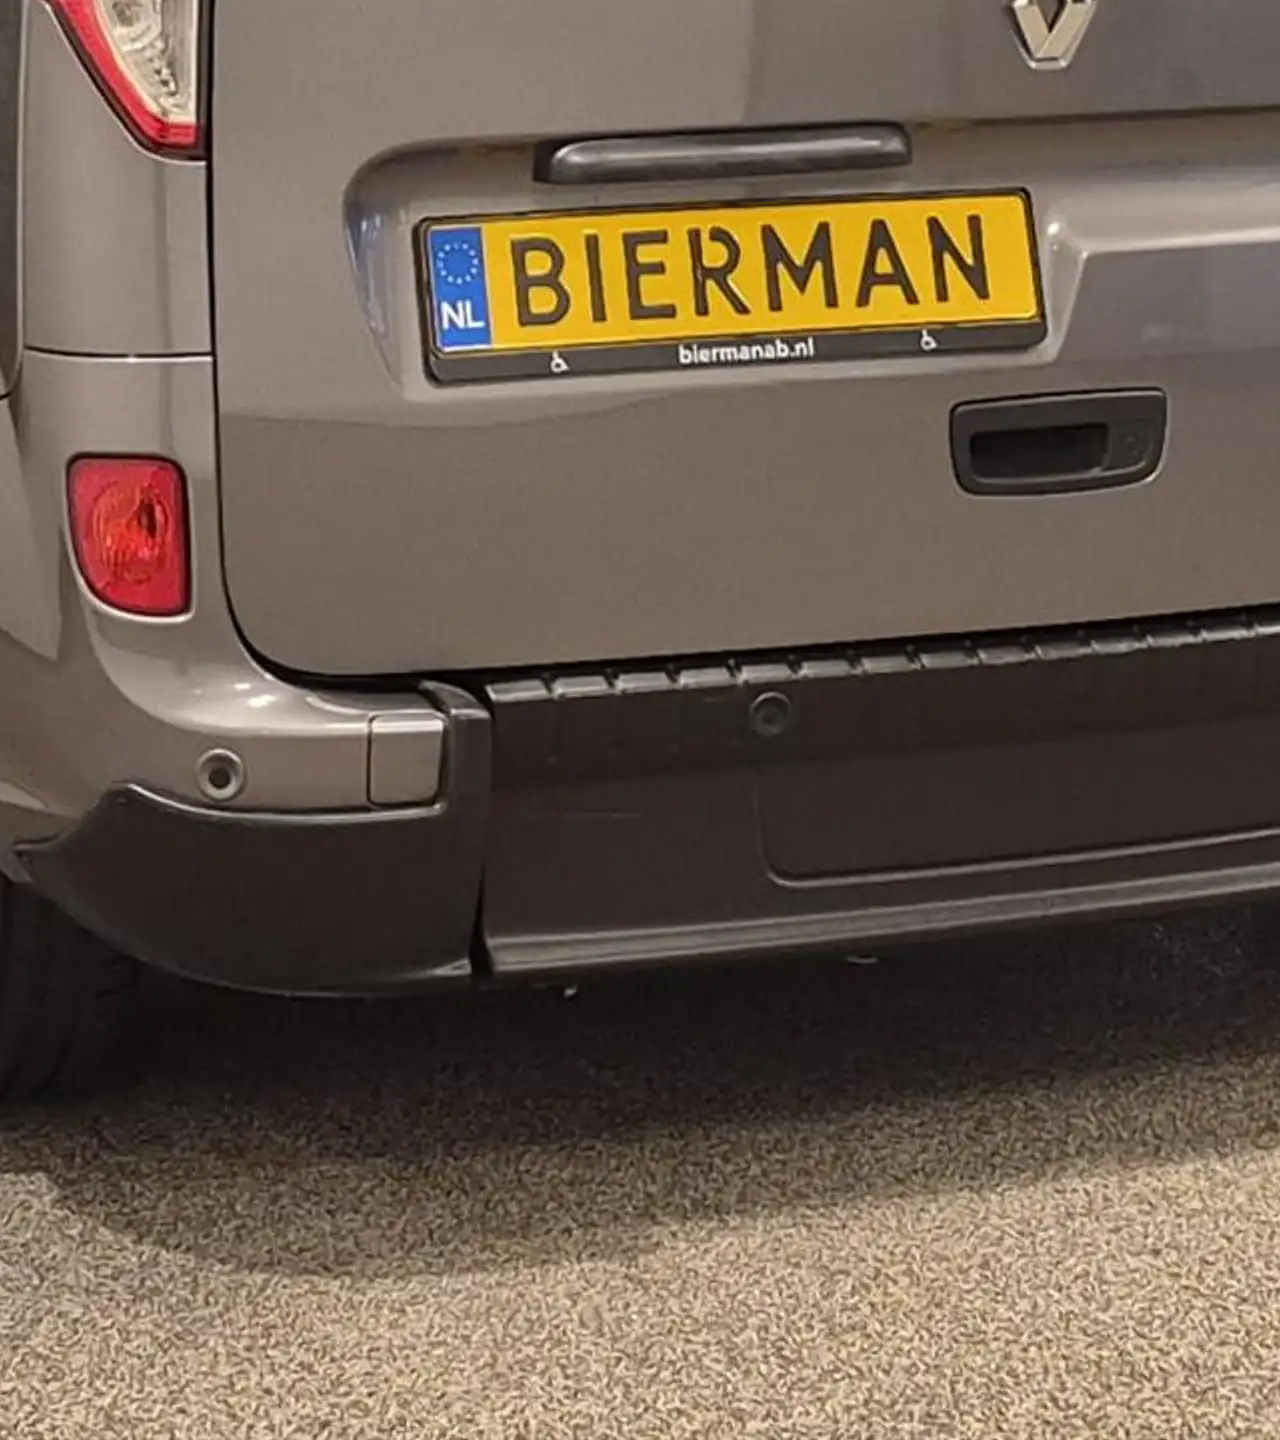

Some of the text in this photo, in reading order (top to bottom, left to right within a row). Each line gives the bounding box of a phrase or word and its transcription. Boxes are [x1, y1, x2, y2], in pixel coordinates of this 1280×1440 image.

[508, 213, 991, 327] BIERMAN
[440, 298, 486, 331] NL
[677, 335, 816, 366] biermanab.nl
